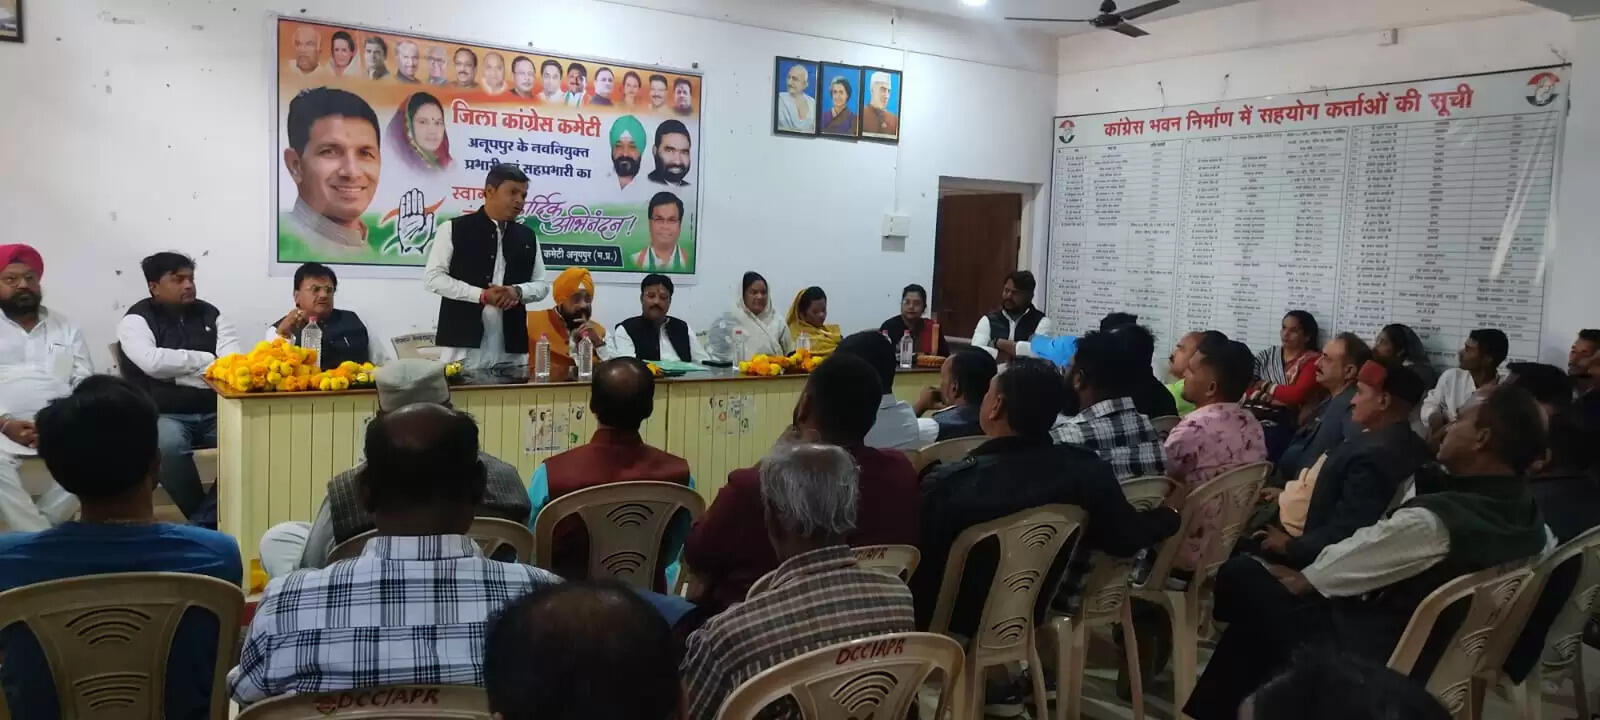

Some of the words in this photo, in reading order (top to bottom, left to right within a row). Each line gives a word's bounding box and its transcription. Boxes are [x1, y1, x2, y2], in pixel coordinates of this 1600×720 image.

[452, 101, 498, 127] जिला
[502, 108, 553, 132] कांग्रेस
[557, 114, 602, 137] कमेटी
[1104, 117, 1144, 137] कांग्रेस
[1150, 116, 1182, 133] भवन
[1186, 107, 1234, 131] निर्माण
[1238, 105, 1254, 126] में
[1258, 99, 1320, 125] सहयोग
[1325, 91, 1390, 118] कर्ताओं
[1394, 88, 1422, 112] की
[1428, 83, 1474, 116] सूची
[468, 137, 514, 154] अनूपपुर
[517, 138, 529, 151] के
[531, 141, 590, 160] नवनियुक्त
[522, 163, 574, 178] सहप्रभारी
[577, 168, 591, 179] का
[543, 247, 565, 259] कमेटी
[337, 688, 440, 709] DCC/APR
